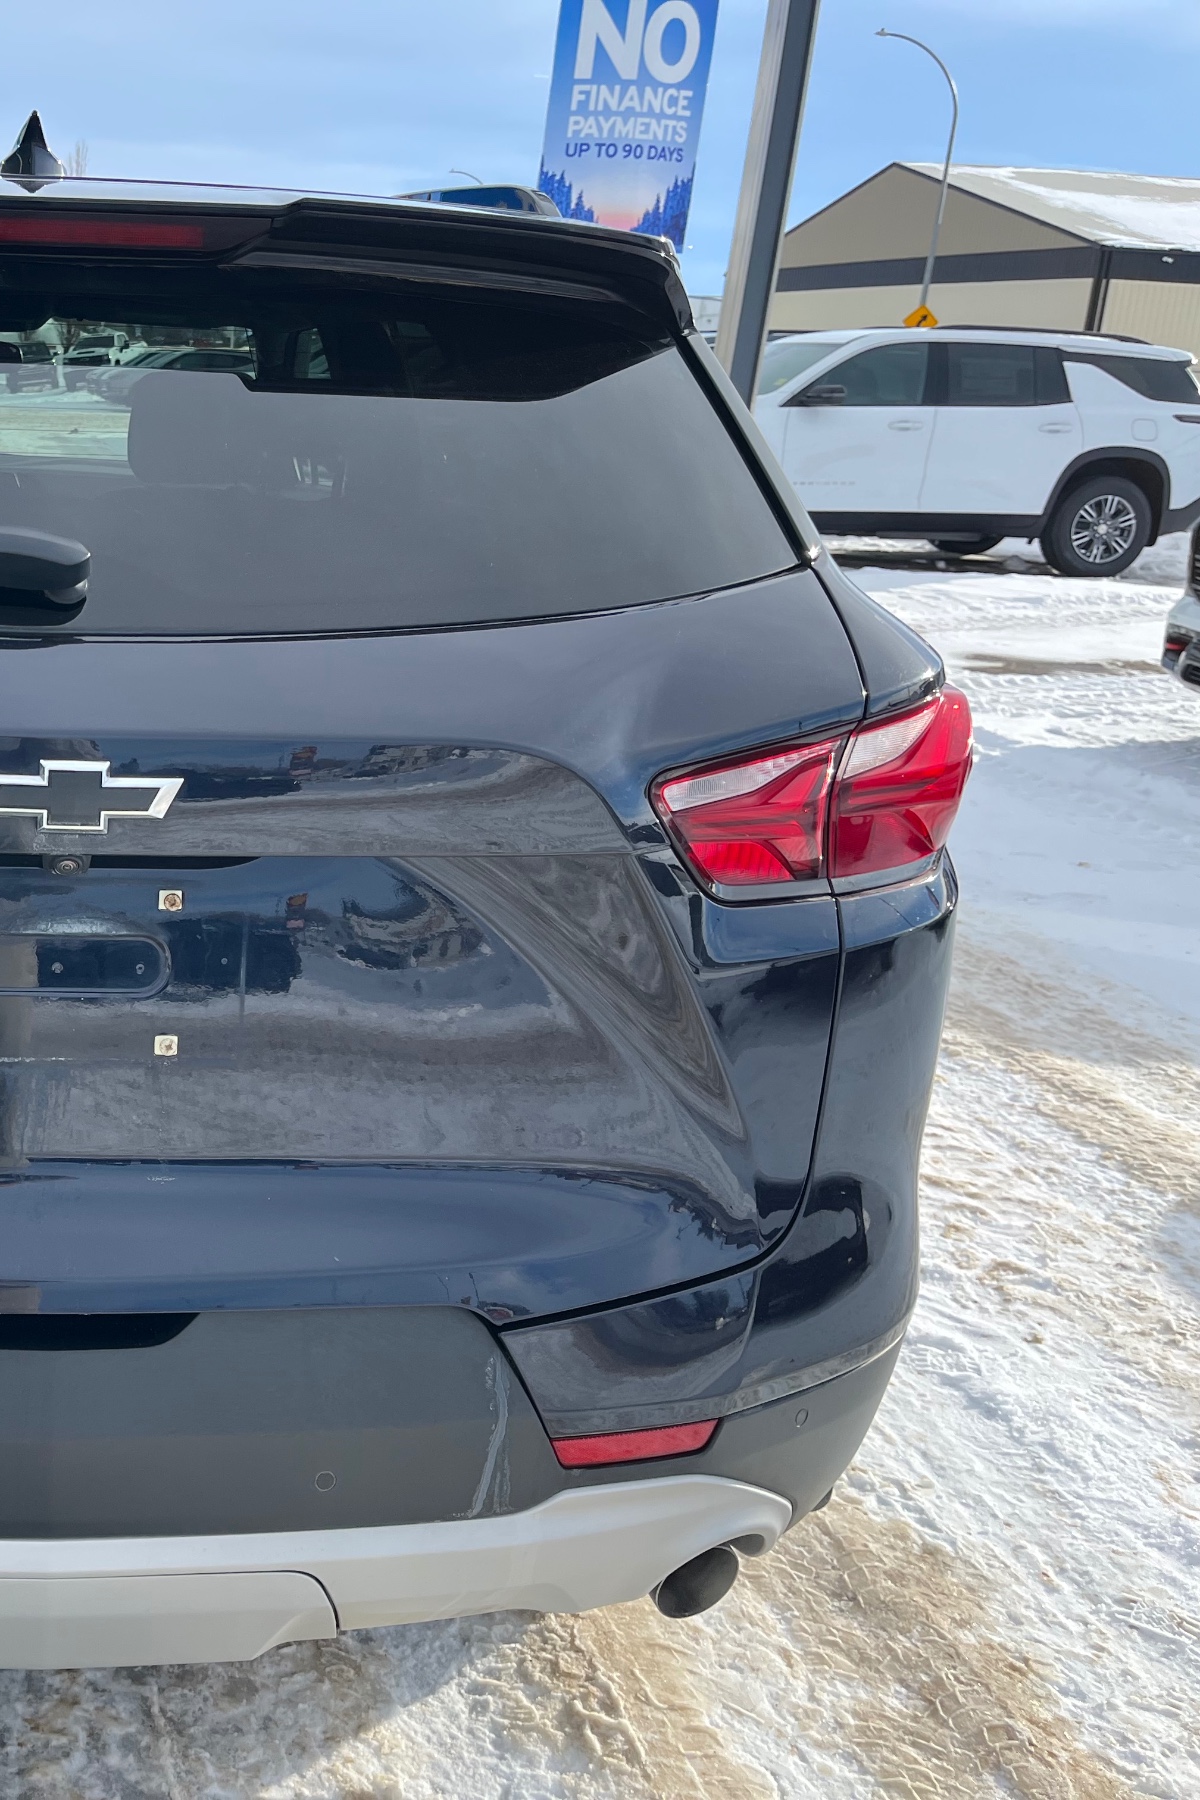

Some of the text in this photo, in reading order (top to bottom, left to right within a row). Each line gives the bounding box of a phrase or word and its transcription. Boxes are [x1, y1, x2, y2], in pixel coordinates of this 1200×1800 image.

[574, 0, 700, 84] NO
[570, 84, 693, 117] FINANCE
[566, 115, 688, 143] PAYMENTS
[565, 142, 684, 163] UP TO 90 DAYS
